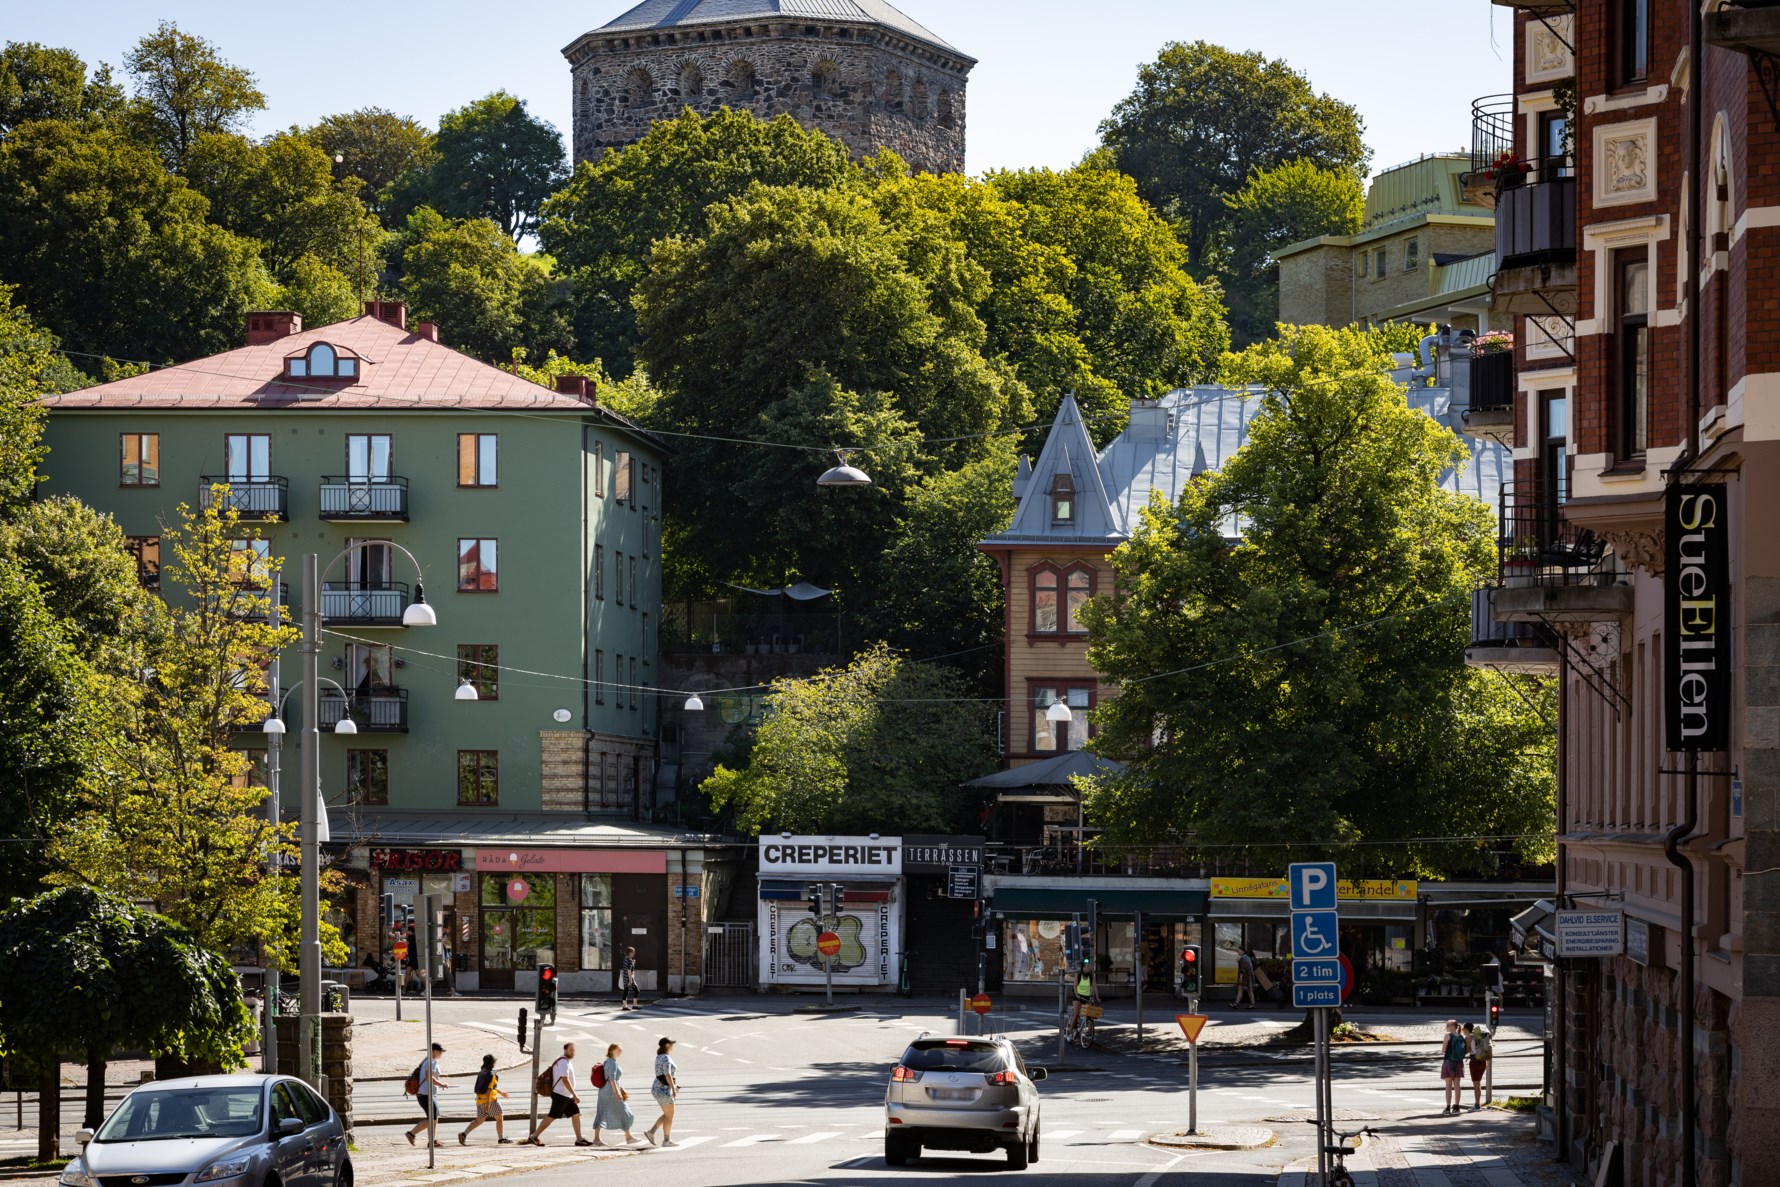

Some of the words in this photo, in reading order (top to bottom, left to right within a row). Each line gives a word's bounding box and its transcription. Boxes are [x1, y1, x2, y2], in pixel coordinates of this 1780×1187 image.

[1679, 494, 1716, 741] SueEllen
[482, 854, 507, 863] RÅDA
[519, 853, 546, 869] Gelato
[764, 844, 897, 865] CREPERIET
[909, 848, 978, 862] TERRASSEN
[1302, 868, 1327, 905] P
[1337, 882, 1395, 896] erhandel
[1560, 915, 1584, 924] DAHLVID
[1586, 914, 1618, 924] ELSERVICE
[880, 906, 888, 981] CREPERIET
[1300, 966, 1309, 977] 2
[1312, 965, 1333, 977] tim
[1299, 991, 1304, 1000] 1
[1307, 990, 1334, 1002] plats
